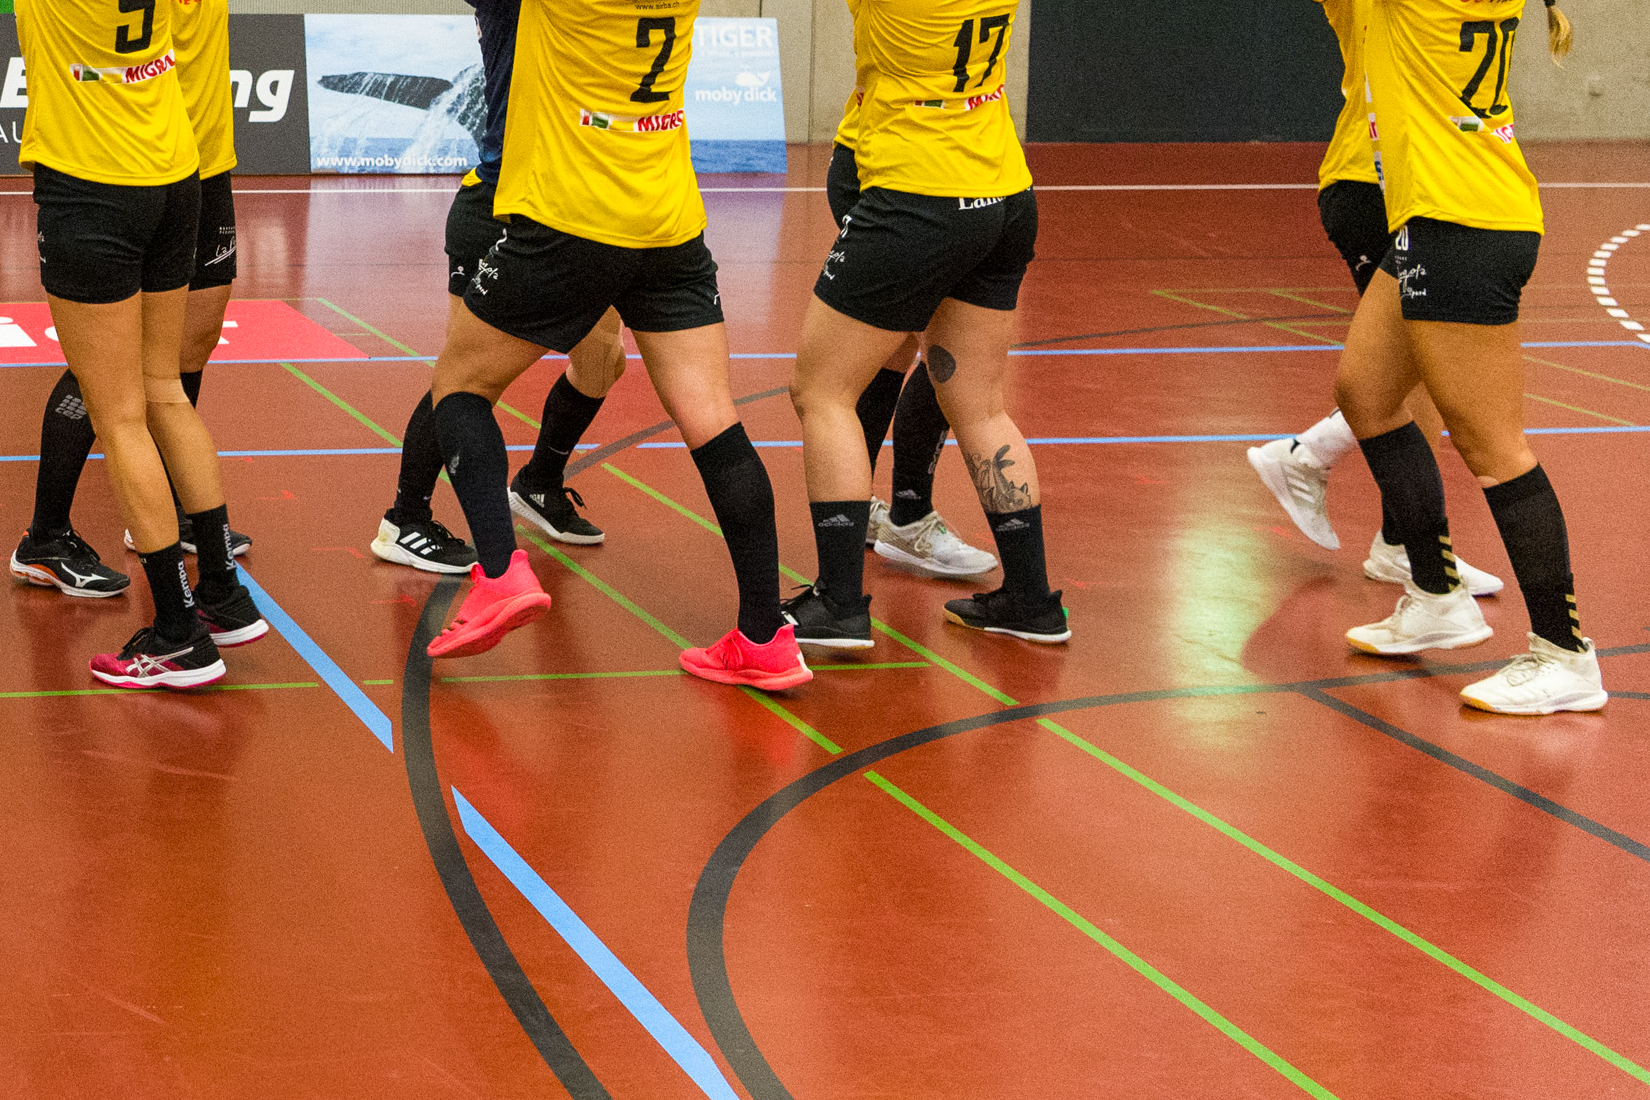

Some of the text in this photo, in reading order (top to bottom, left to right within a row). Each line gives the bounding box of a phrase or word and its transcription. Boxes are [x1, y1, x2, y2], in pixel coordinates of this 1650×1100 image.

[630, 16, 676, 103] 2
[694, 24, 773, 48] TIGER
[953, 13, 1010, 93] 17
[695, 86, 778, 106] moby dick
[316, 154, 468, 170] www.mobydick.com
[222, 523, 238, 571] Kempa
[177, 560, 196, 609] Kempa
